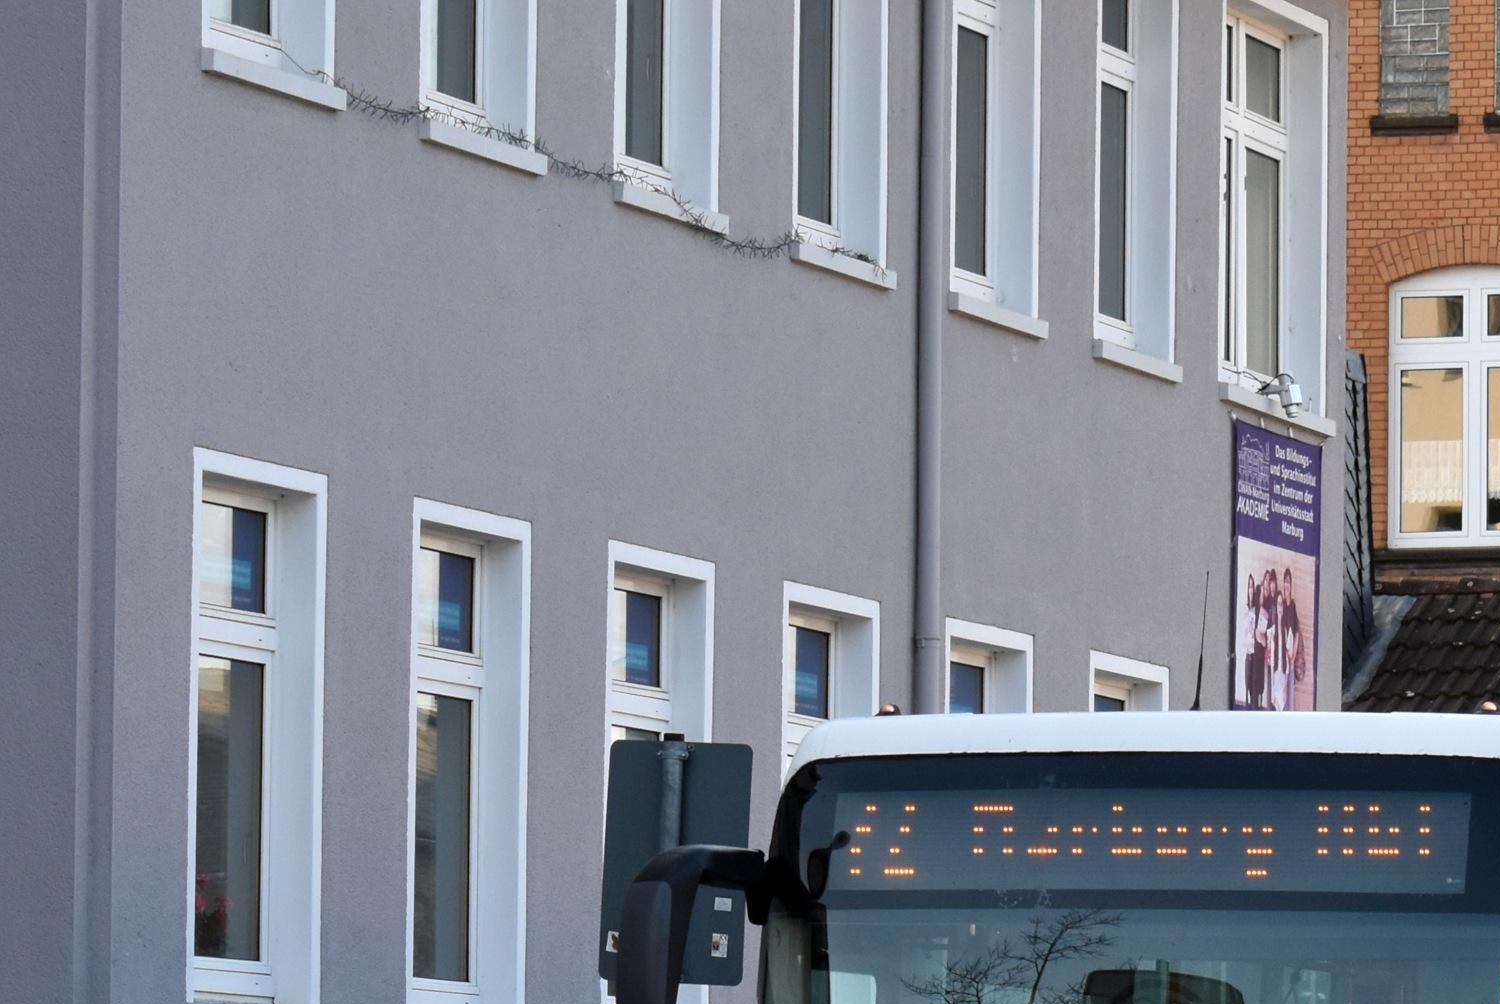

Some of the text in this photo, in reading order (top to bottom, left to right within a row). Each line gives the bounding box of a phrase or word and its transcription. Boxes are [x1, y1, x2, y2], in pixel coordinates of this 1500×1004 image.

[1275, 445, 1312, 468] Das Bildungs-
[1270, 463, 1316, 487] und Sprachinstitut
[1273, 481, 1313, 504] im Zentrum der
[1237, 496, 1269, 521] AKADEMIE
[1271, 499, 1314, 523] Universitätsstadt
[1282, 521, 1304, 541] Marburg
